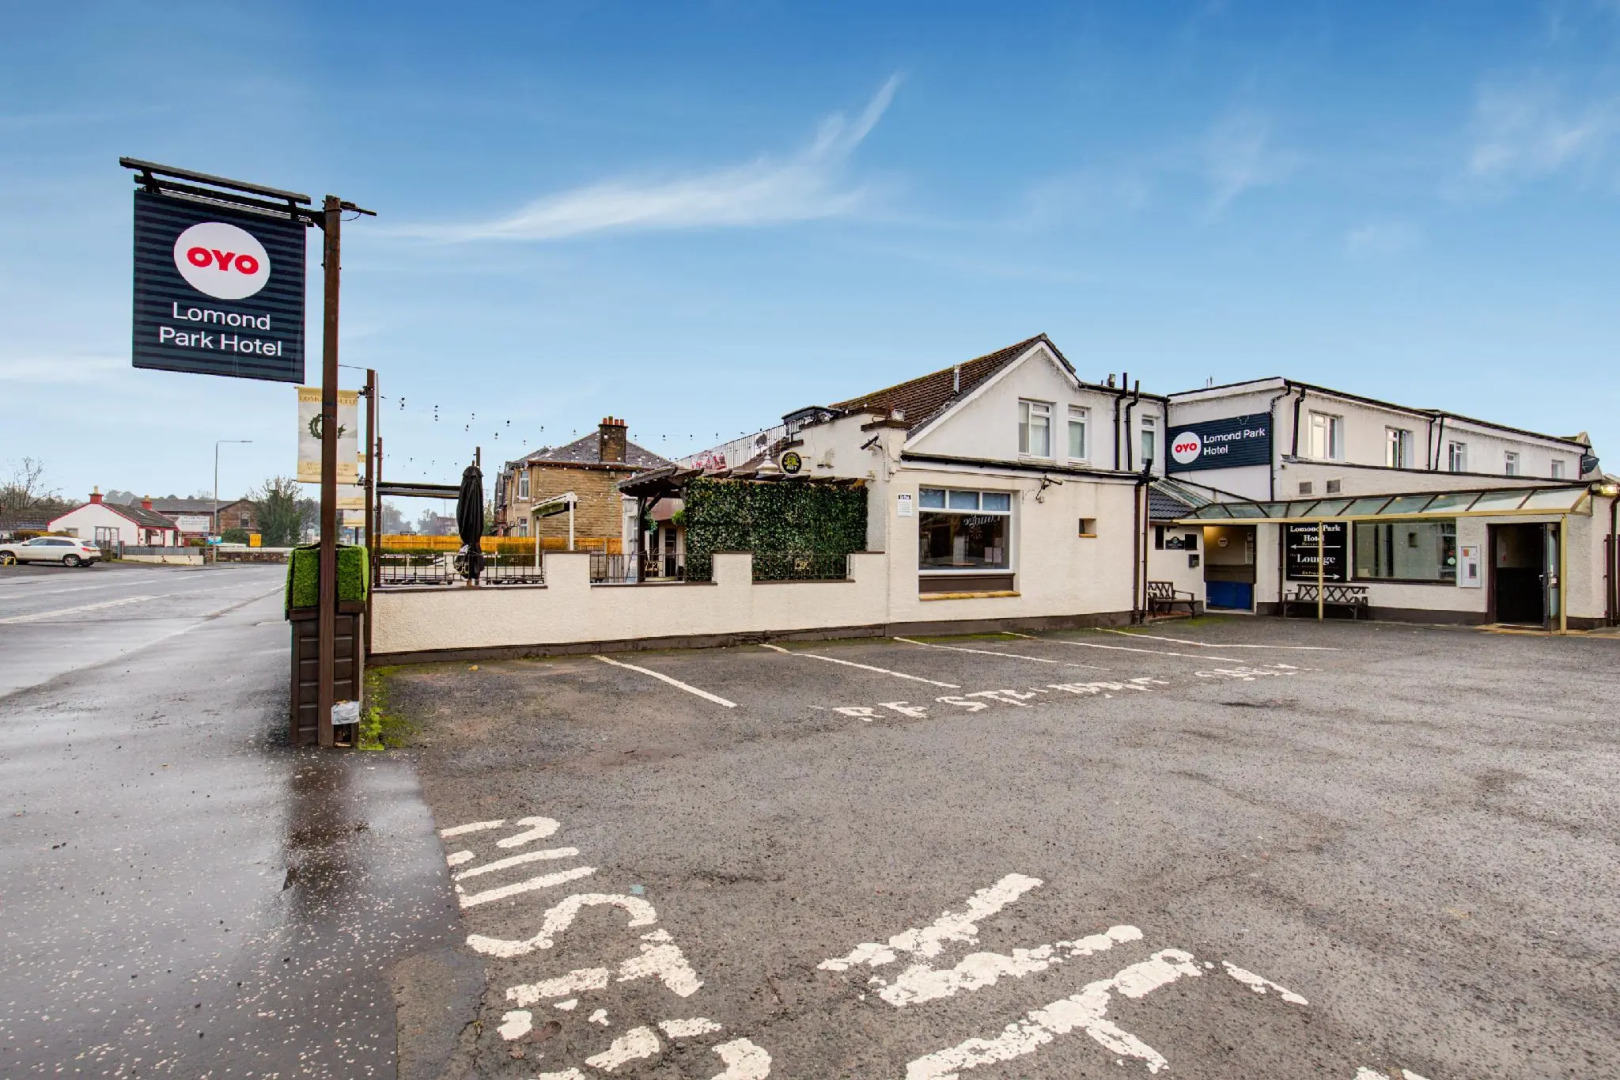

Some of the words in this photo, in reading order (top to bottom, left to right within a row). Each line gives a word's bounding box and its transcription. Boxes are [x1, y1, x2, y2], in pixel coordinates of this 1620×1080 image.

[187, 247, 259, 275] OYO
[173, 301, 271, 330] Lomond
[159, 326, 214, 349] Park
[220, 333, 282, 356] Hotel
[1203, 431, 1241, 443] Lomond
[1243, 428, 1266, 439] Park
[1175, 443, 1197, 453] OYO
[1203, 445, 1228, 455] Hotel
